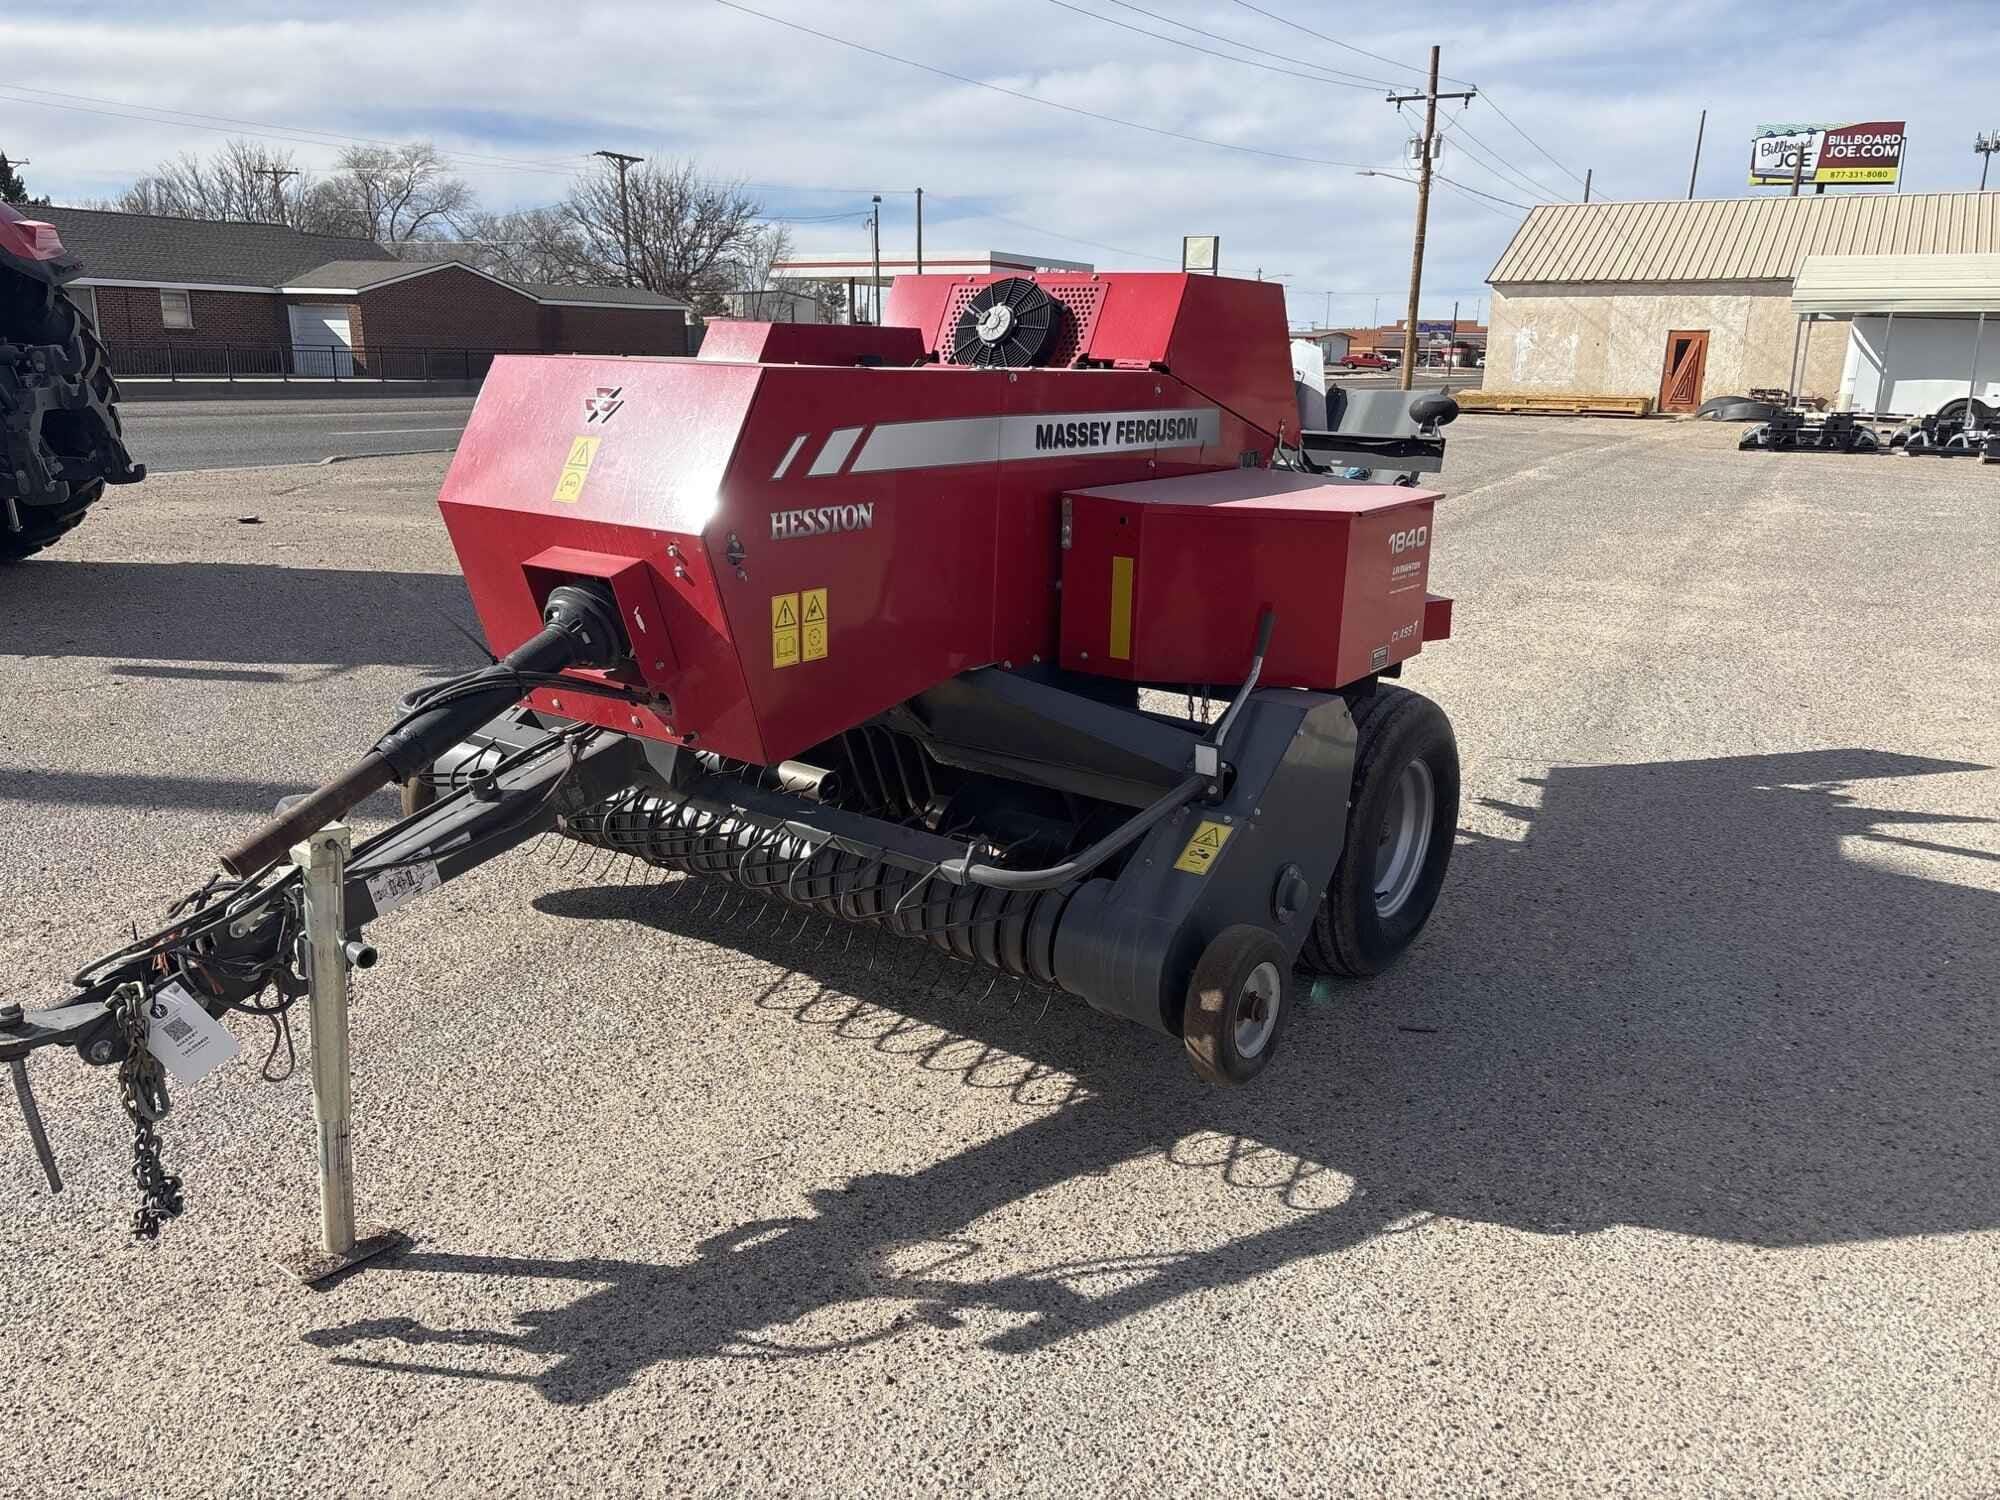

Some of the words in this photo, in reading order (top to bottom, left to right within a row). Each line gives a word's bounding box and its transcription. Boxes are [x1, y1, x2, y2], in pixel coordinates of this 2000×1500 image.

[1828, 134, 1902, 145] BILLBOARD
[1774, 152, 1812, 168] JOE
[1825, 145, 1899, 158] JOE.COM
[1035, 421, 1111, 450] MASSEY
[1116, 417, 1198, 445] FERGUSON
[770, 502, 874, 541] HESSTON
[1388, 526, 1427, 555] 1840
[1391, 625, 1413, 643] CLASS
